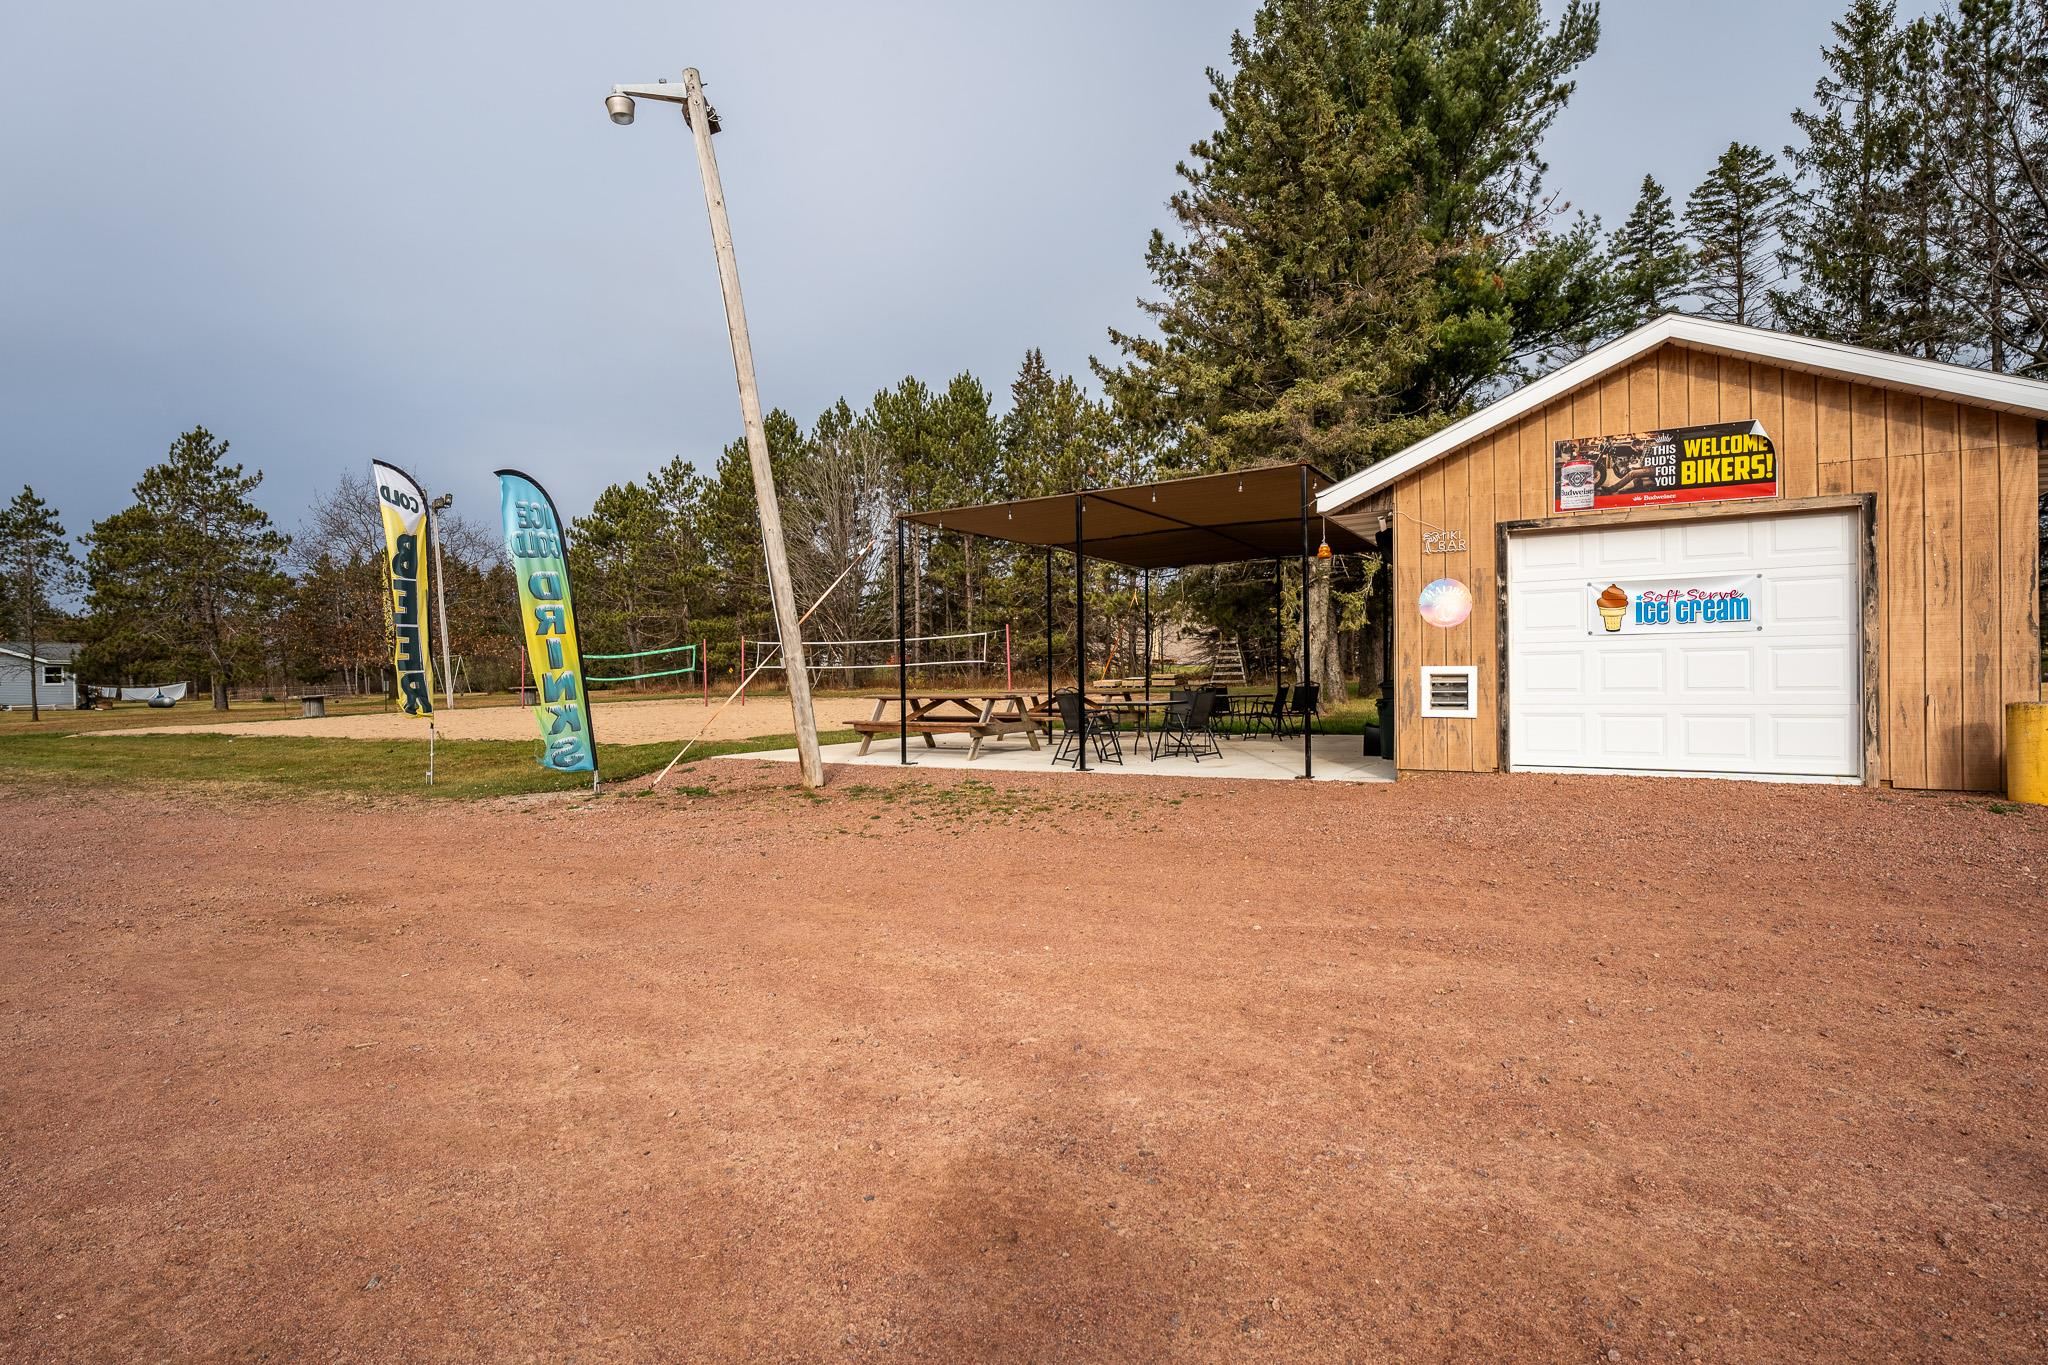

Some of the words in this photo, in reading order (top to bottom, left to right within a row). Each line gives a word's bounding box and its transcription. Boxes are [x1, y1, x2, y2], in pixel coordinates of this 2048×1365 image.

[1652, 444, 1676, 455] THIS
[1683, 434, 1768, 458] WELCOME
[1644, 455, 1676, 467] BUD'S
[1655, 466, 1676, 476] FOR
[1681, 453, 1773, 485] BIKERS!
[1655, 476, 1676, 487] YOU
[1441, 530, 1461, 541] TIKI
[1438, 540, 1466, 550] BAR
[1643, 589, 1684, 606] Soft
[1687, 588, 1744, 602] Serve
[1635, 595, 1669, 624] ice
[1675, 597, 1751, 624] cream
